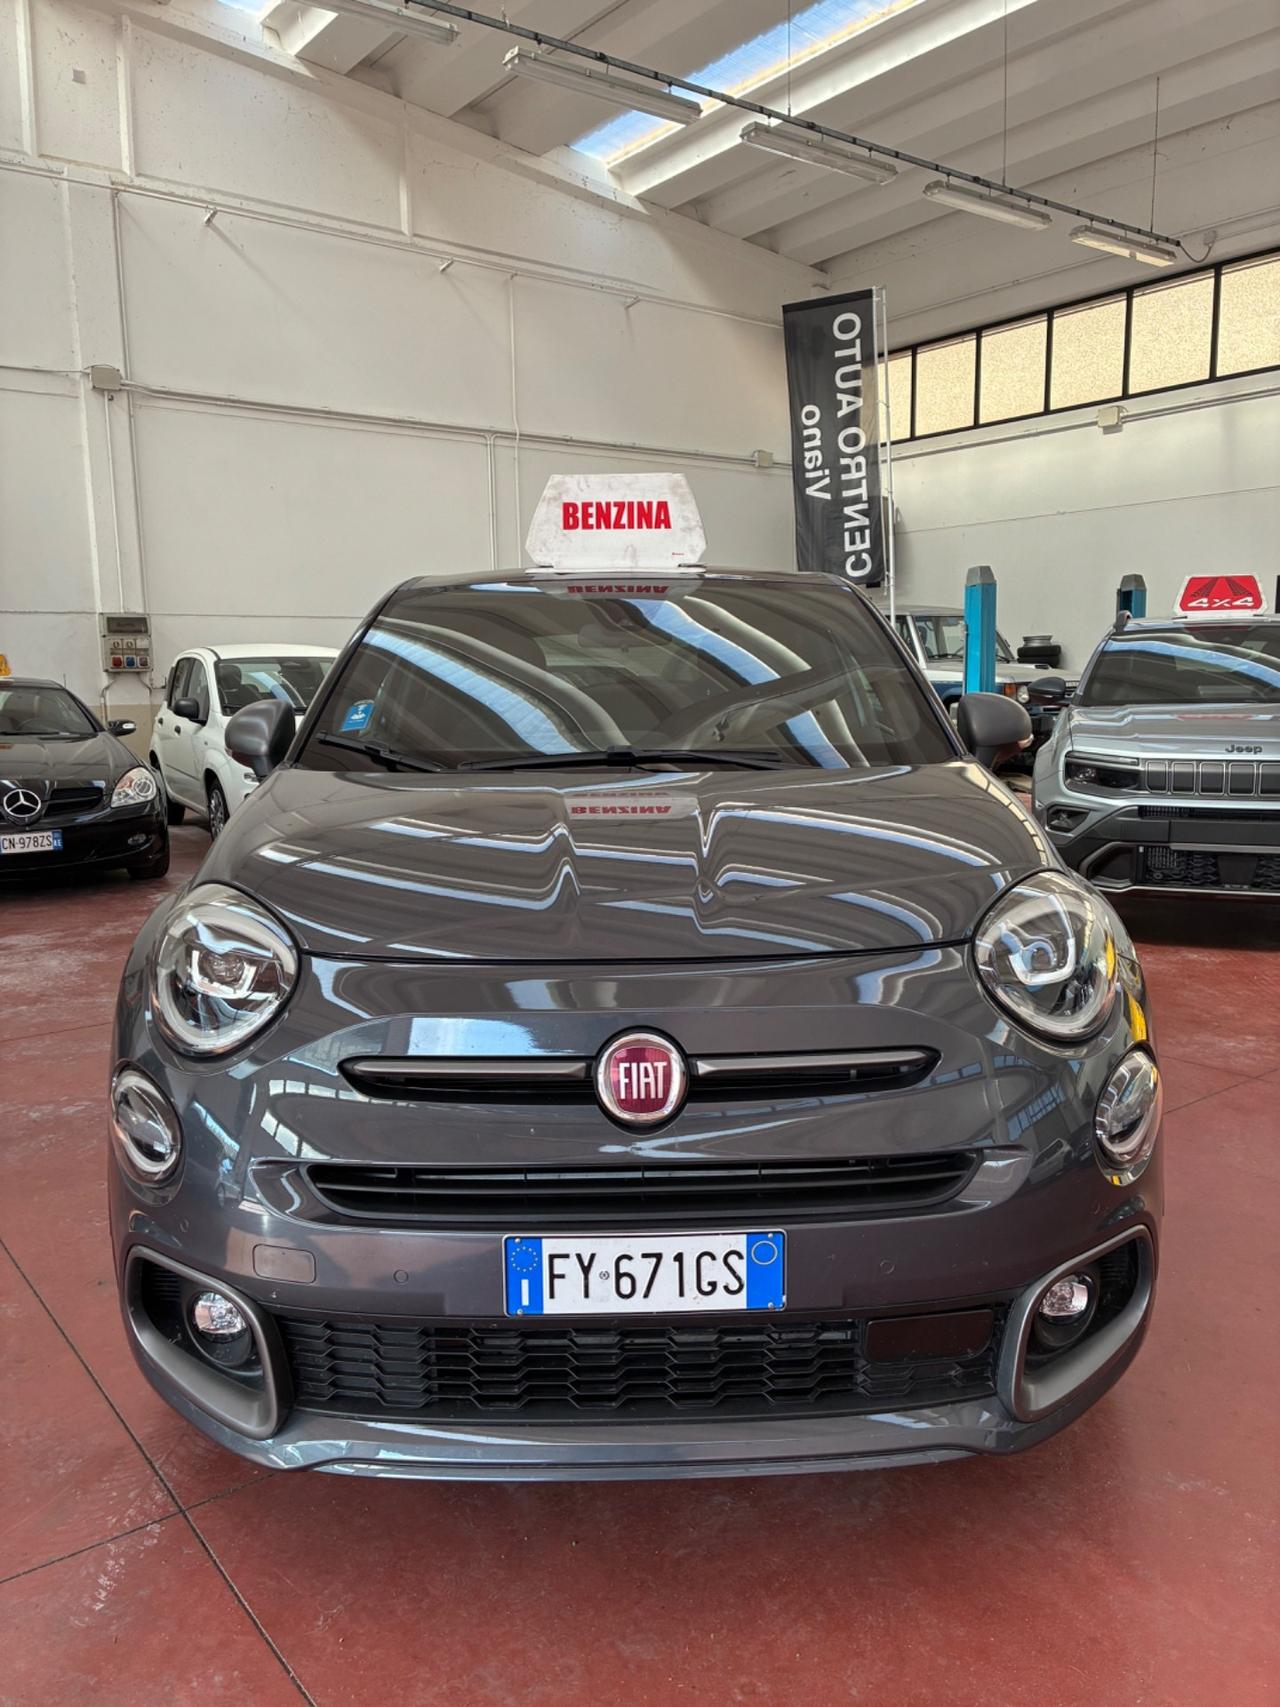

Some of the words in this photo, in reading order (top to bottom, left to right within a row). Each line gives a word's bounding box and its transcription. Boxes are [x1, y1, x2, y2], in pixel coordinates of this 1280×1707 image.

[563, 502, 671, 530] BENZINA
[1225, 744, 1263, 755] Jeep
[619, 1062, 667, 1099] FIAT
